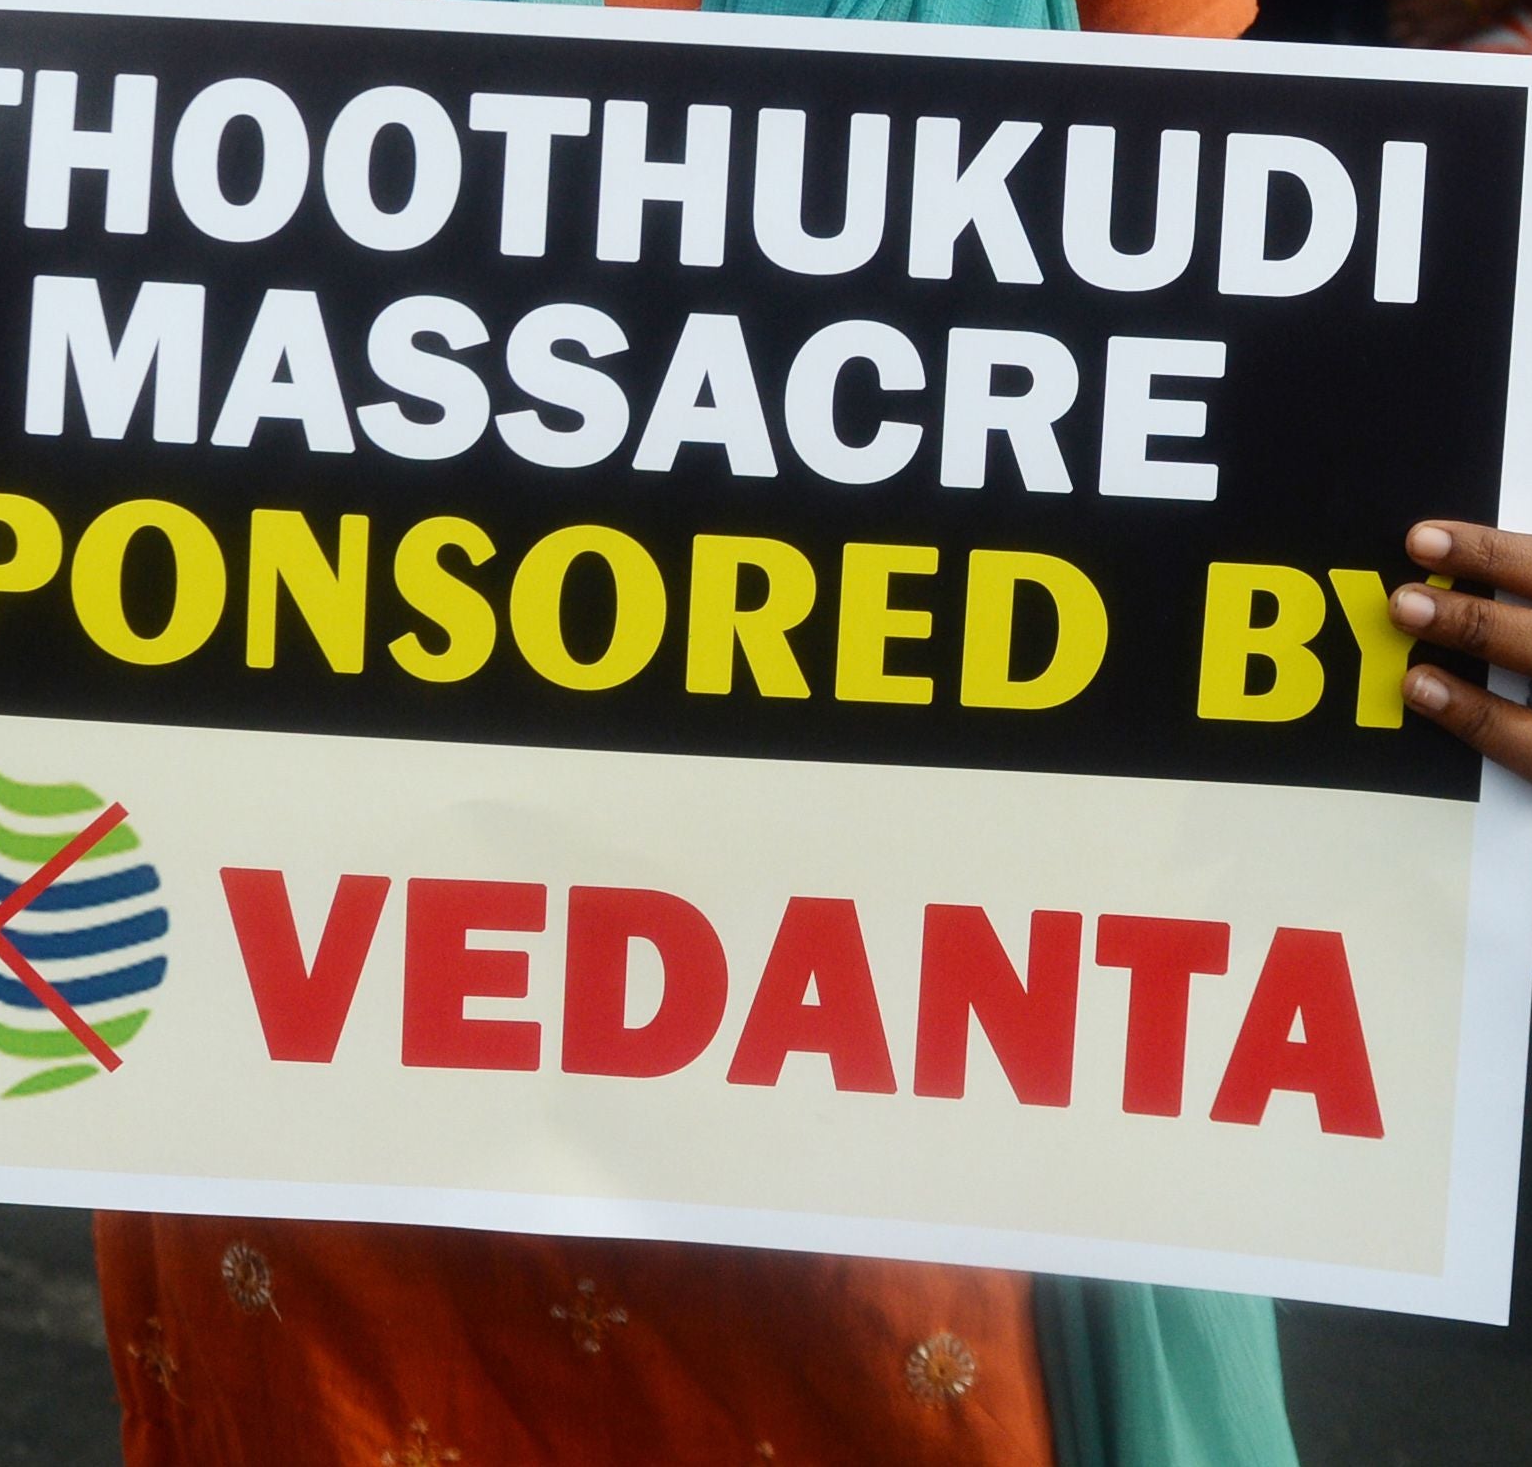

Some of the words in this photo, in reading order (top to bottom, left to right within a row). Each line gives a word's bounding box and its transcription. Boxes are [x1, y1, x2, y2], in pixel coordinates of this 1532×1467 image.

[24, 273, 1227, 503] MASSACRE
[1197, 561, 1455, 731] BY
[217, 865, 1388, 1141] VEDANTA
